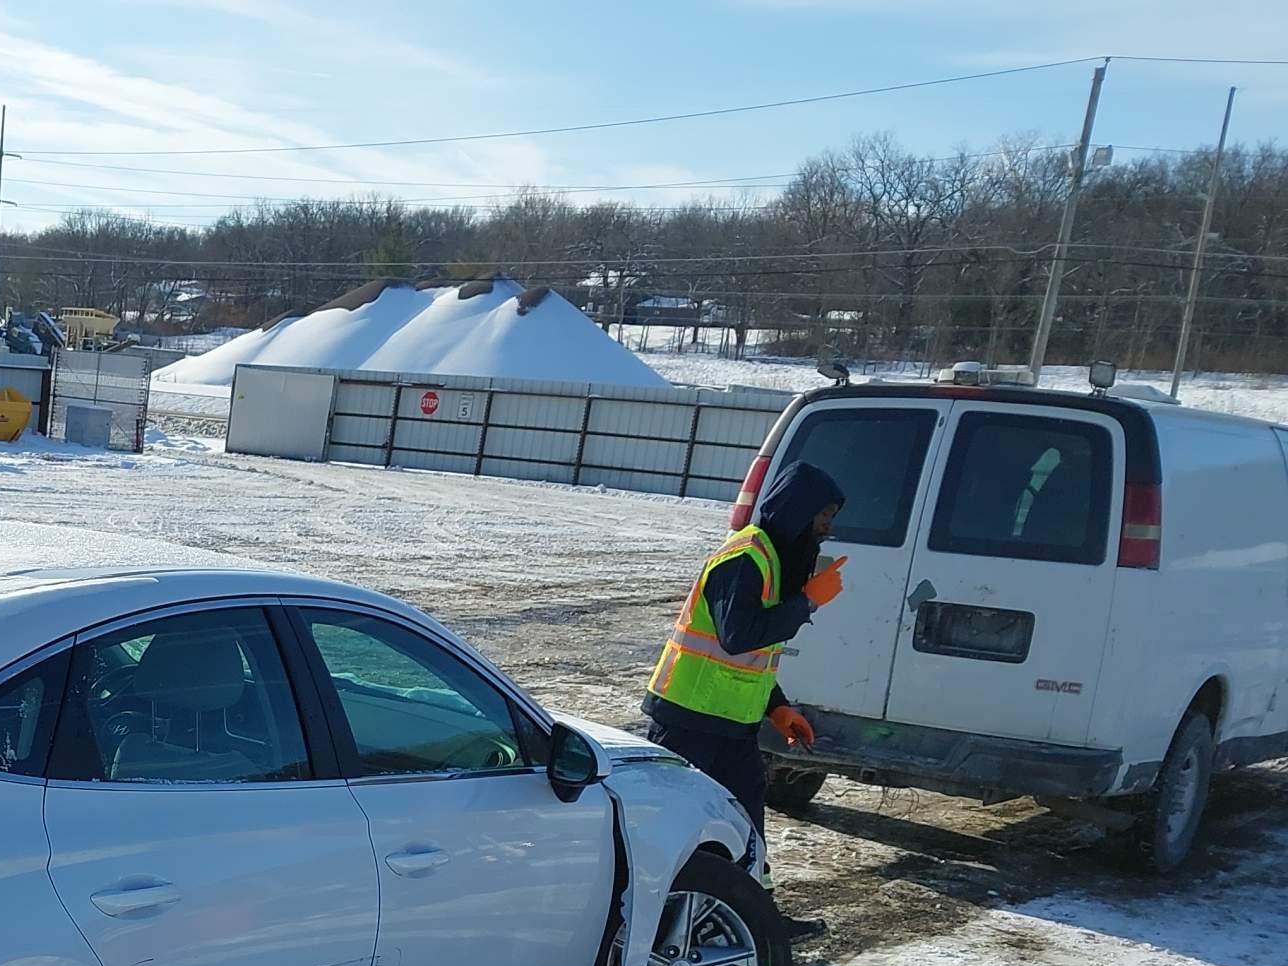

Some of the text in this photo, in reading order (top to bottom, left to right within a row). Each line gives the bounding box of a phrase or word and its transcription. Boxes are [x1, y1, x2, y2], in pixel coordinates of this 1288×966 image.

[421, 398, 438, 409] STOP
[461, 407, 468, 417] 5
[1035, 678, 1083, 694] GMC
